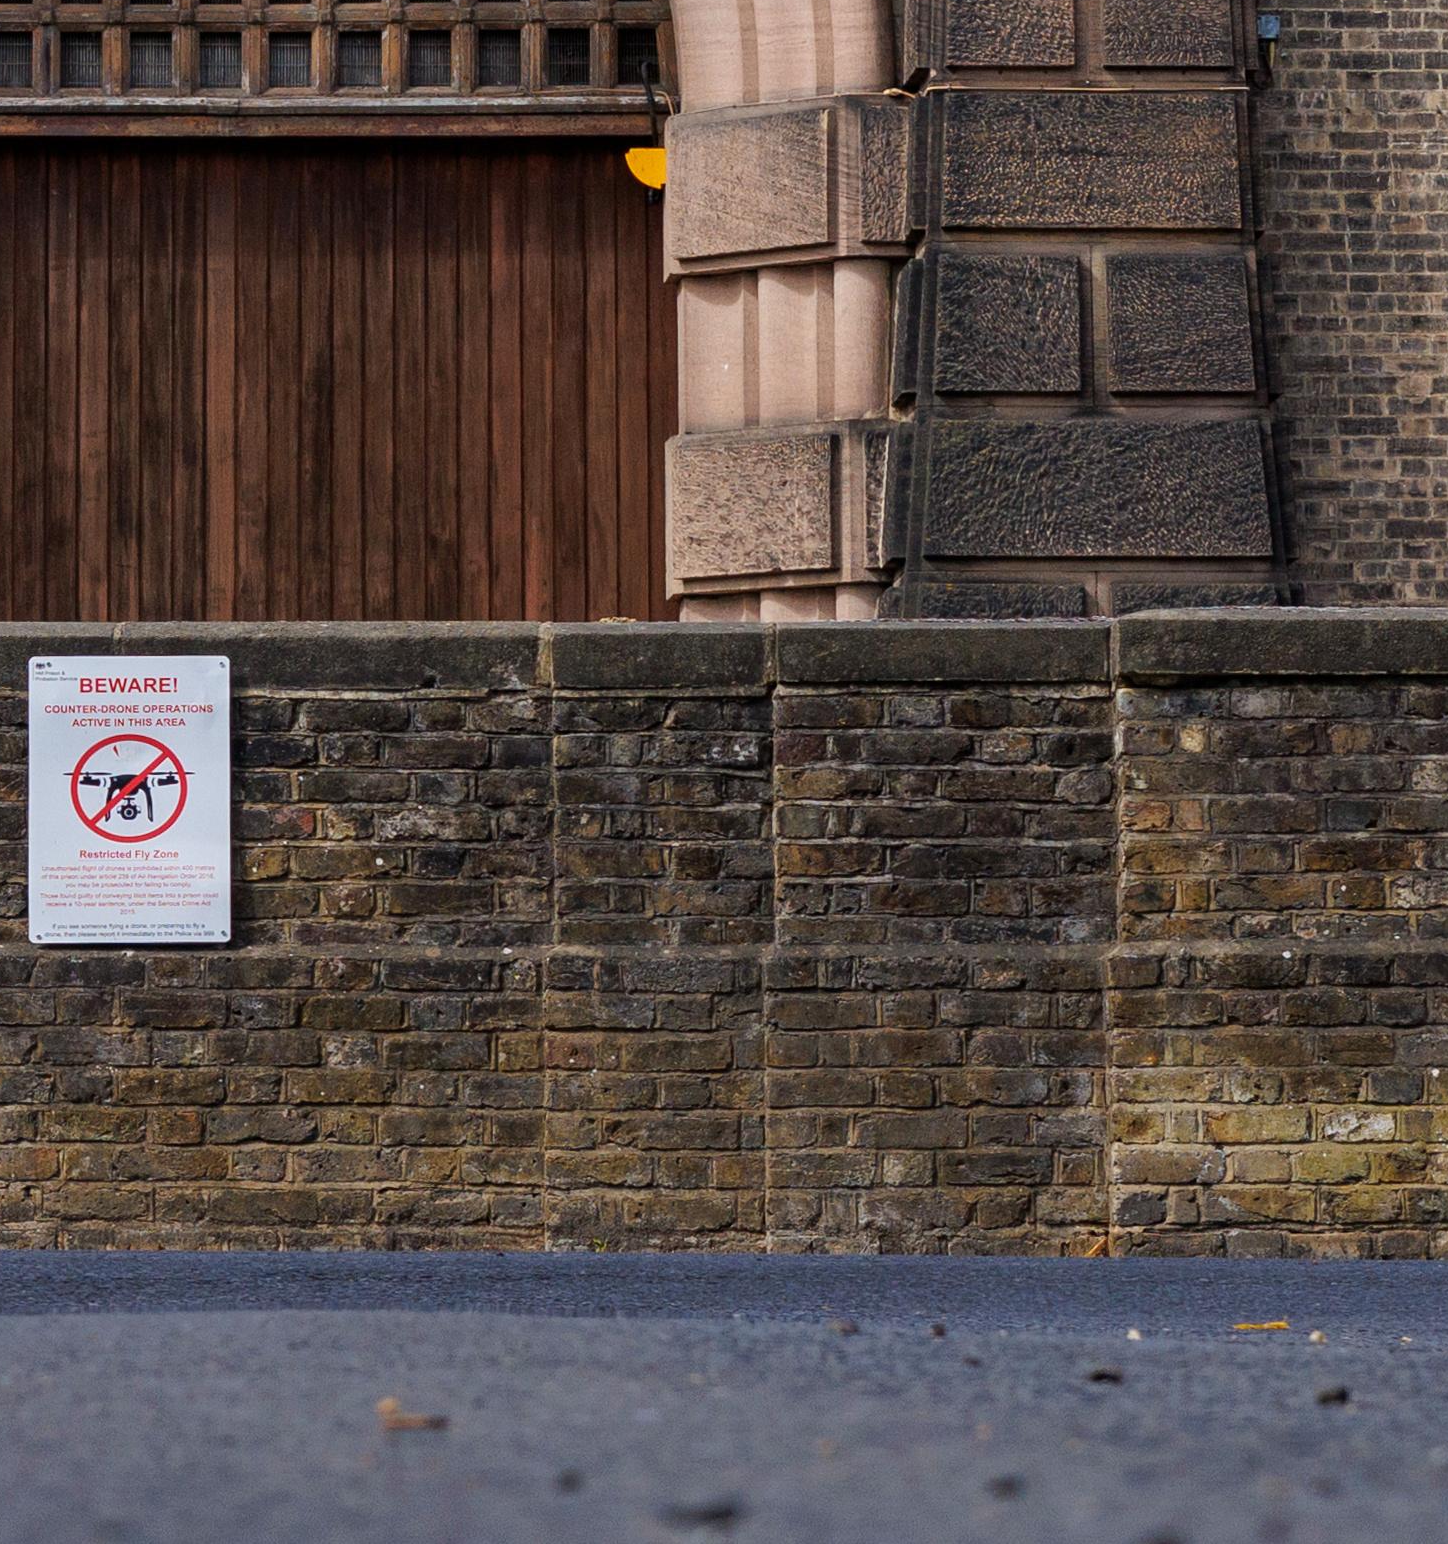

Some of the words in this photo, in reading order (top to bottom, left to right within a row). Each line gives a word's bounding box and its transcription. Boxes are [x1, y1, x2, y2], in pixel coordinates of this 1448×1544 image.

[80, 677, 178, 693] BEWARE!
[45, 705, 139, 713] COUNTER-DRONE
[143, 705, 213, 713] OPERATIONS
[72, 718, 111, 727] ACTIVE
[114, 719, 124, 727] IN
[128, 718, 152, 727] THIS
[156, 718, 186, 726] AREA
[80, 850, 131, 858] Restricted
[135, 850, 150, 860] Fly
[153, 850, 178, 858] Zone
